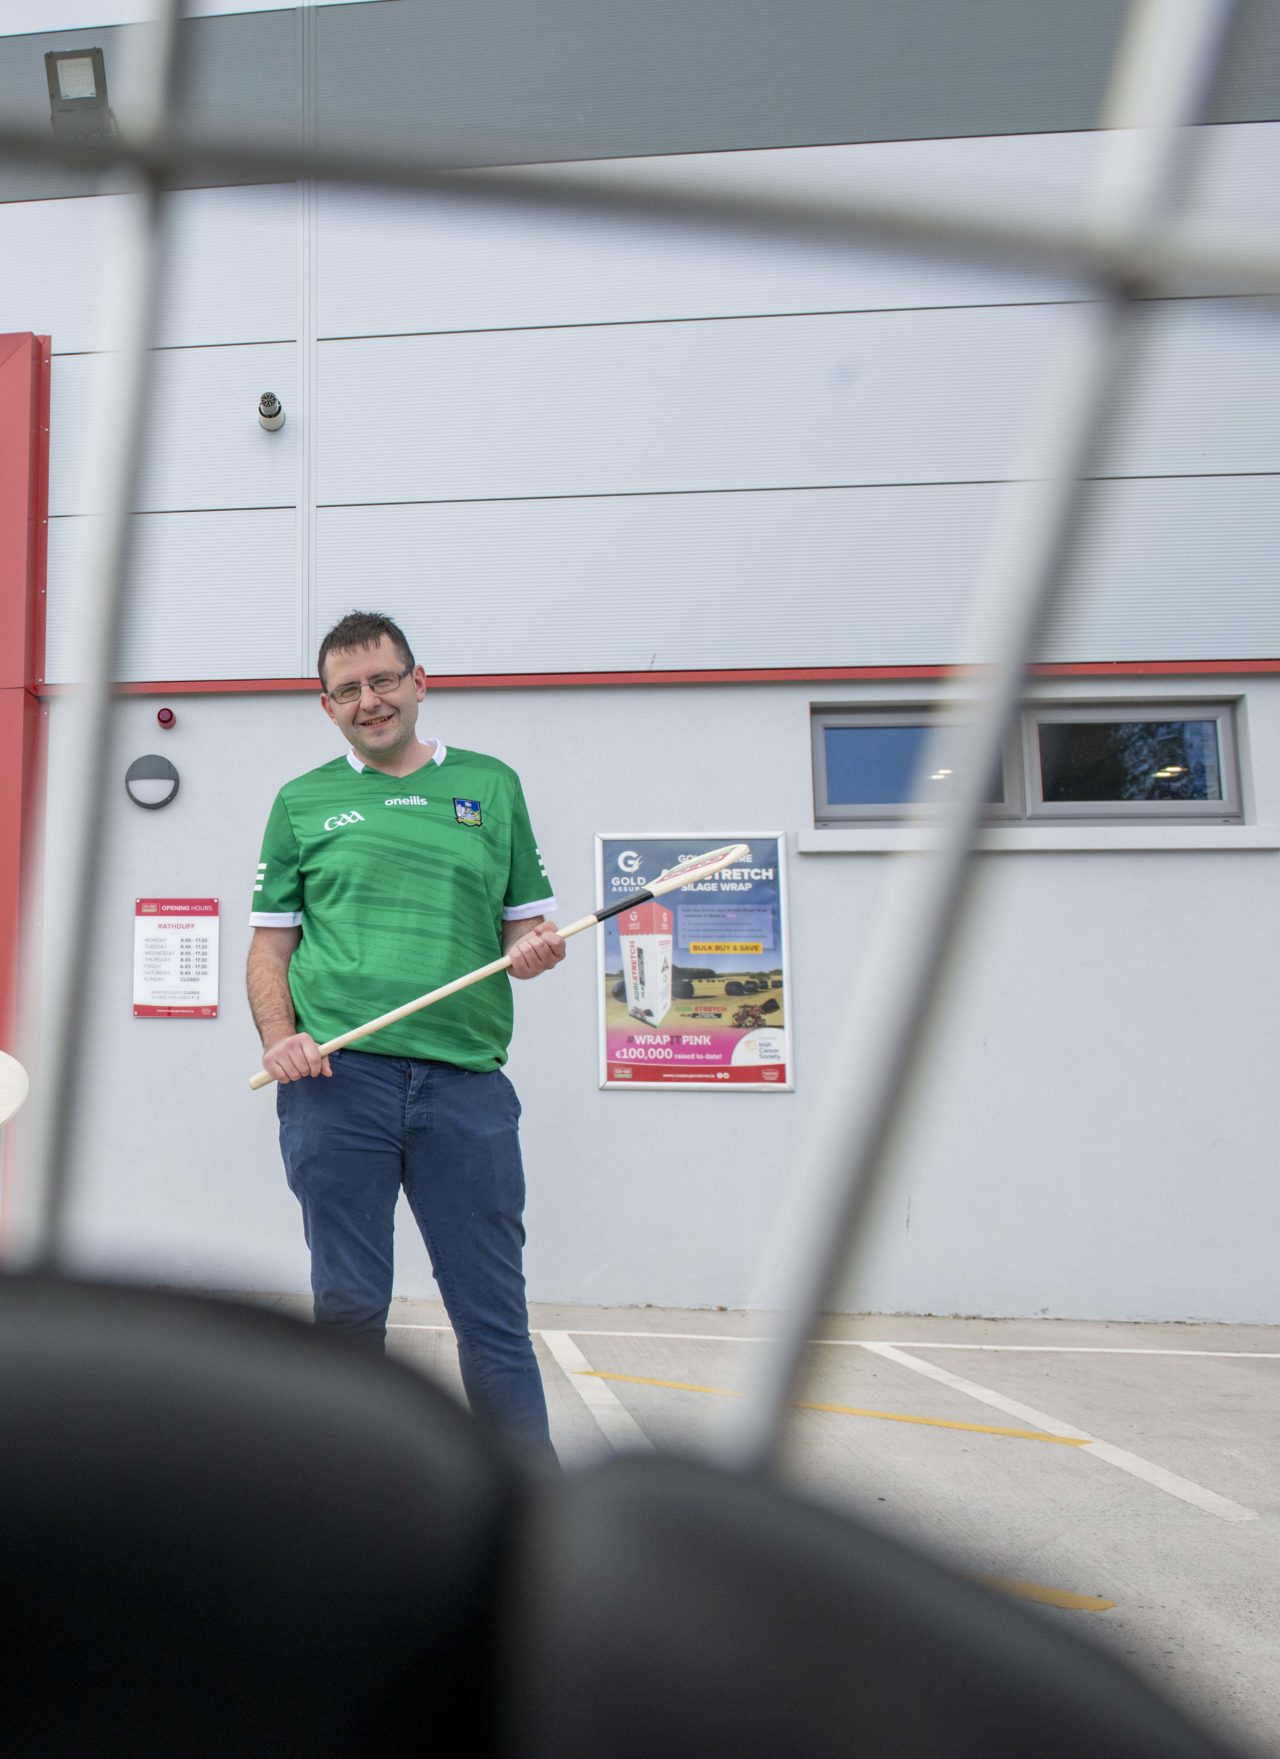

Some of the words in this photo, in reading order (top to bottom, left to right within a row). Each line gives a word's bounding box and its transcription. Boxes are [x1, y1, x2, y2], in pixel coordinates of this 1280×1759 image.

[324, 811, 365, 831] GAA
[611, 876, 646, 886] GOLD
[681, 882, 718, 892] SILAGE
[720, 882, 753, 892] WRAP
[615, 1048, 673, 1060] €100,000
